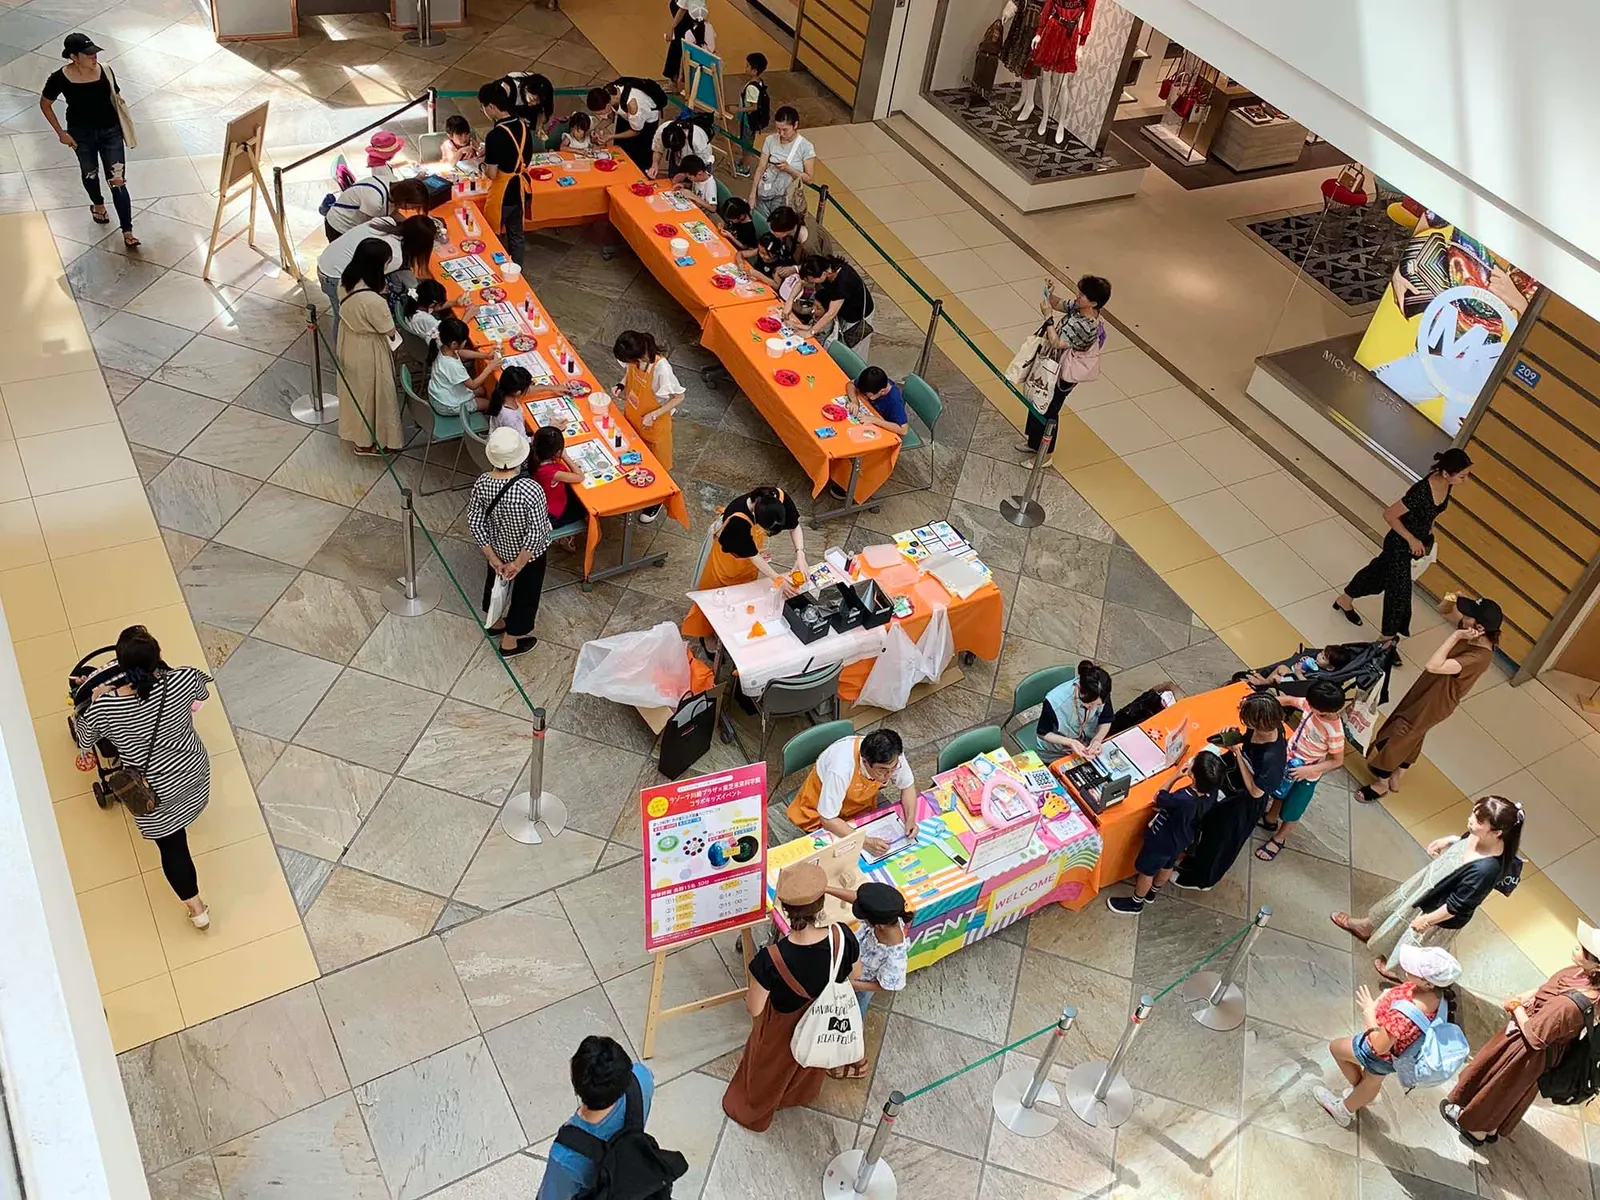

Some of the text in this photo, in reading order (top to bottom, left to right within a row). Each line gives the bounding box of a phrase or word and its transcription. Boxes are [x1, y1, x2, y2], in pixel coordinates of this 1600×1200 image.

[1518, 364, 1537, 380] 209
[994, 872, 1056, 911] WELCOME
[906, 904, 984, 953] VENT
